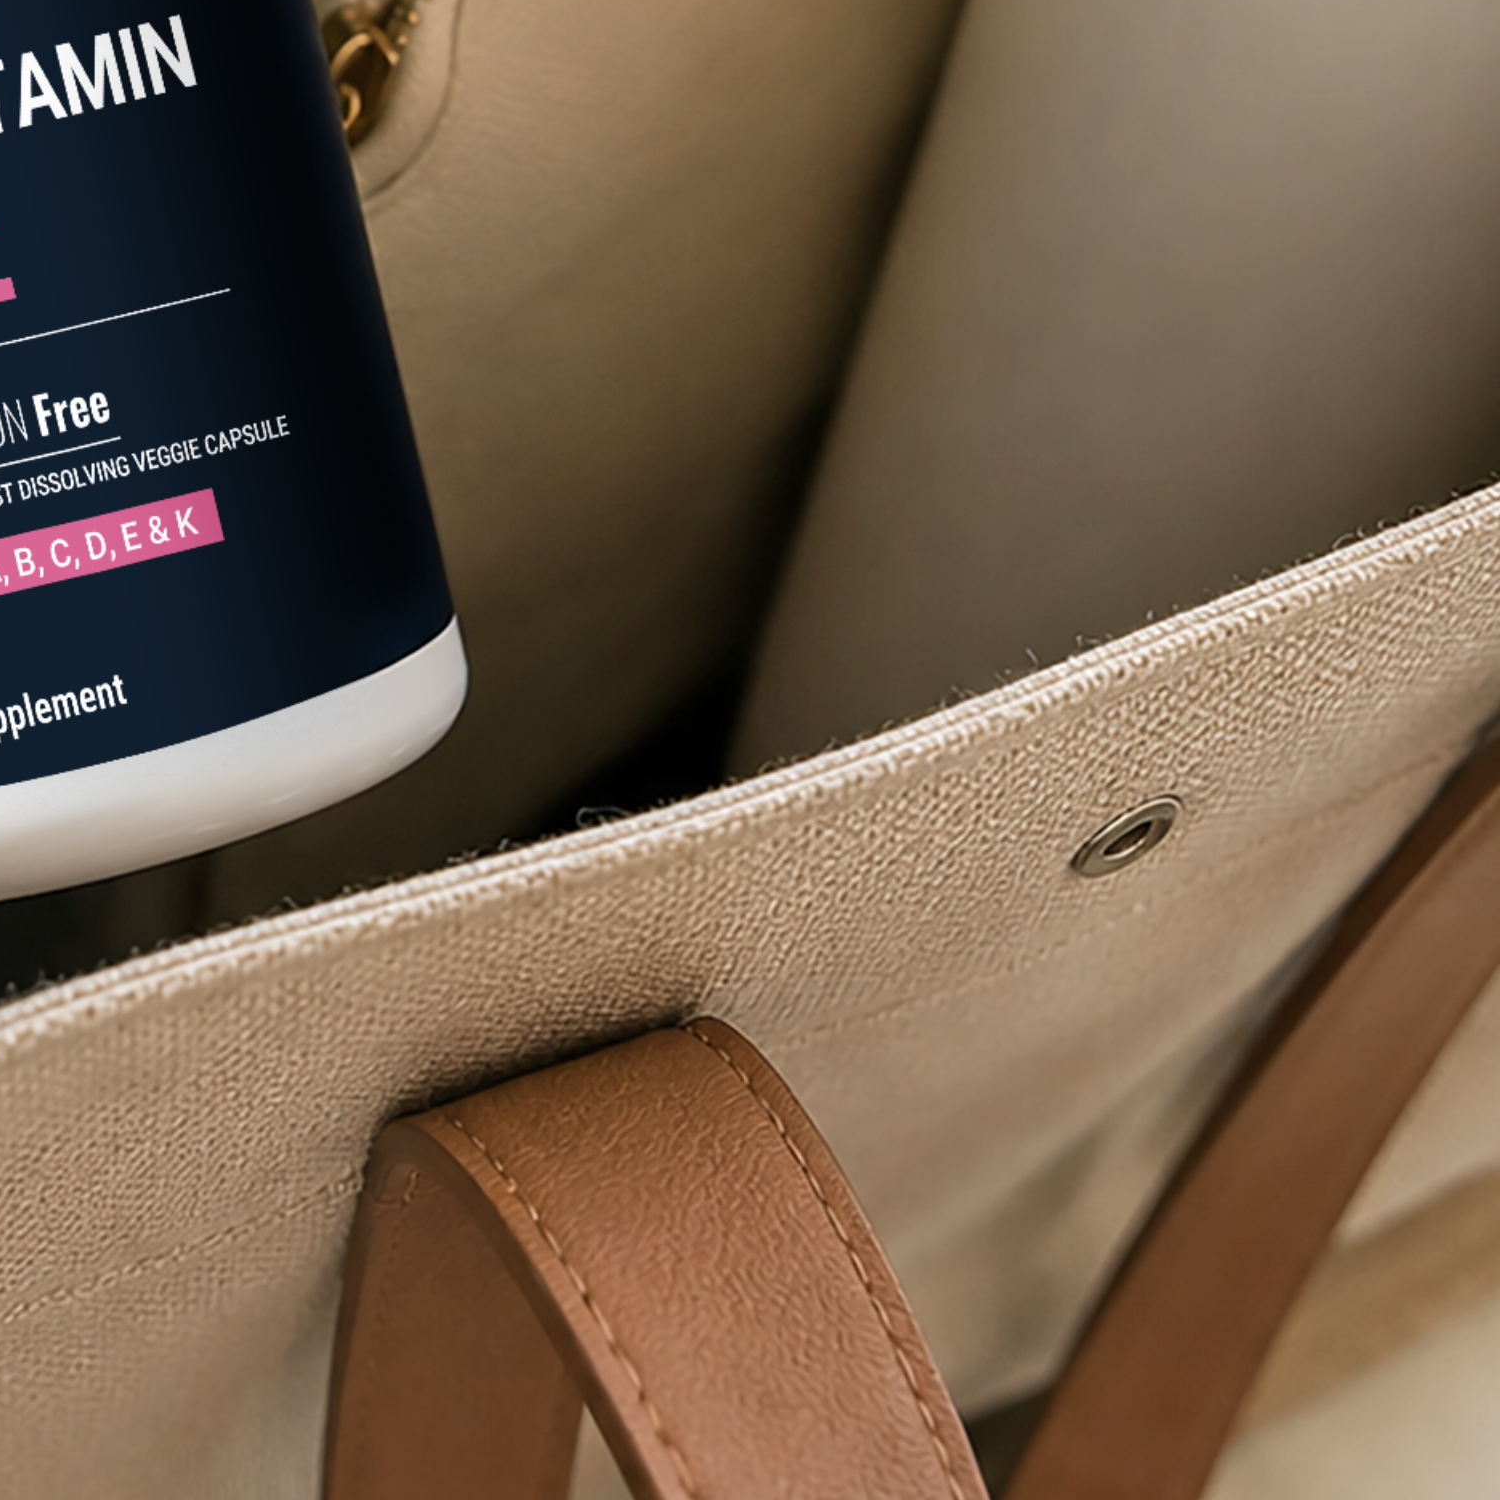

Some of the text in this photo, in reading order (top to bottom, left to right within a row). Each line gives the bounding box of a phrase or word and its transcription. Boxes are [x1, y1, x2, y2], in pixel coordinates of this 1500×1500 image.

[31, 391, 110, 437] Free
[17, 455, 131, 501] DISSOLVING
[130, 437, 202, 472] VEGGIE
[204, 414, 290, 455] CAPSULE
[13, 547, 45, 578] B,
[49, 538, 80, 570] C,
[84, 531, 117, 562] D,
[120, 520, 142, 552] E
[148, 515, 171, 545] &
[174, 506, 199, 538] K
